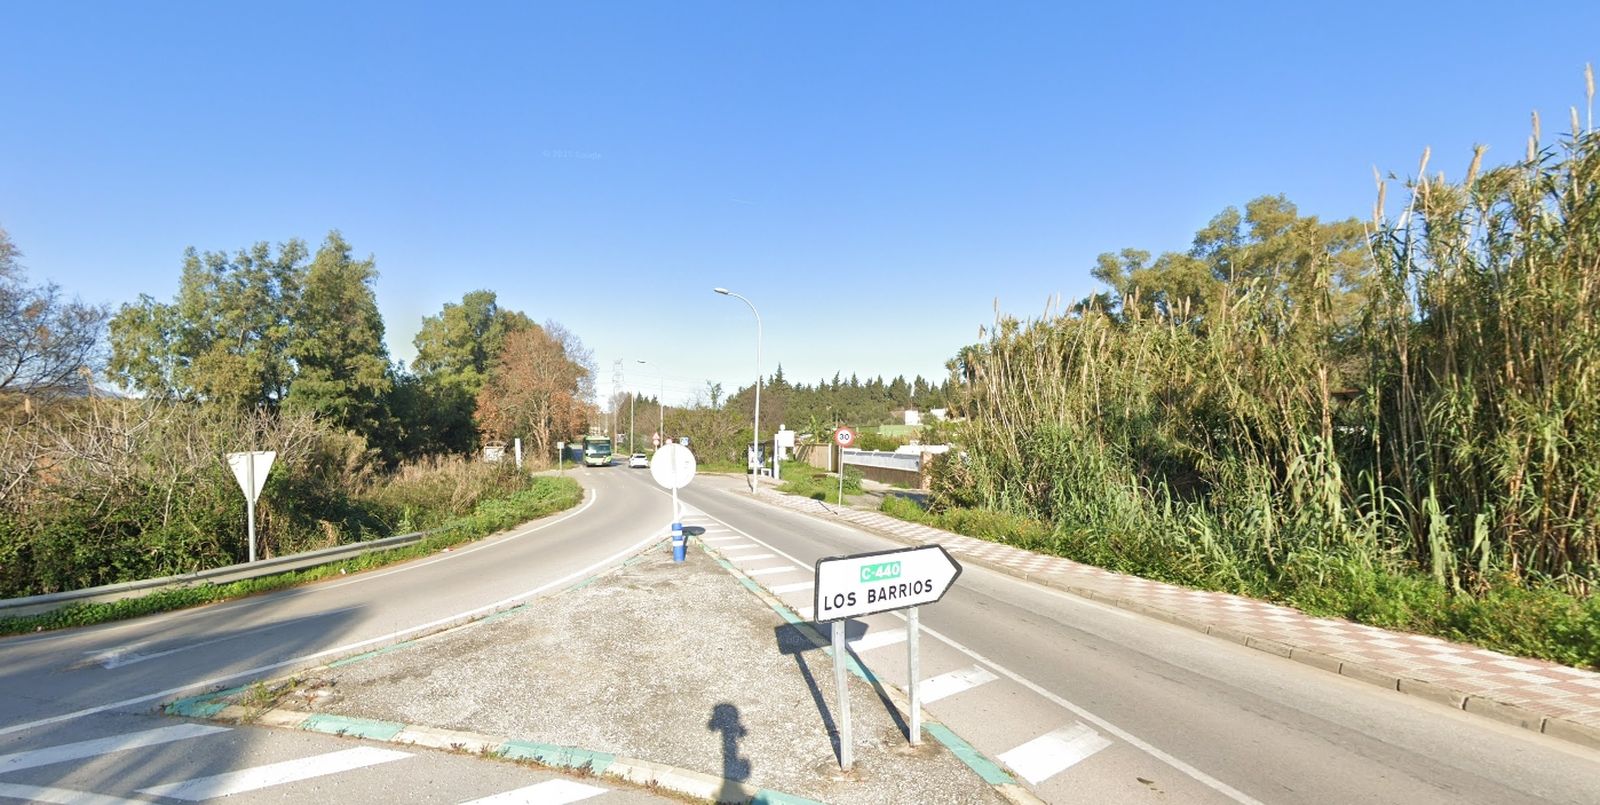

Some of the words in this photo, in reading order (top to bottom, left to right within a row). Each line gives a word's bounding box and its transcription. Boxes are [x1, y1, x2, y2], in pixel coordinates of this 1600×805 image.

[839, 433, 850, 441] 30
[861, 563, 900, 580] C-440
[824, 592, 857, 611] LOS
[867, 579, 933, 604] BARRIOS
